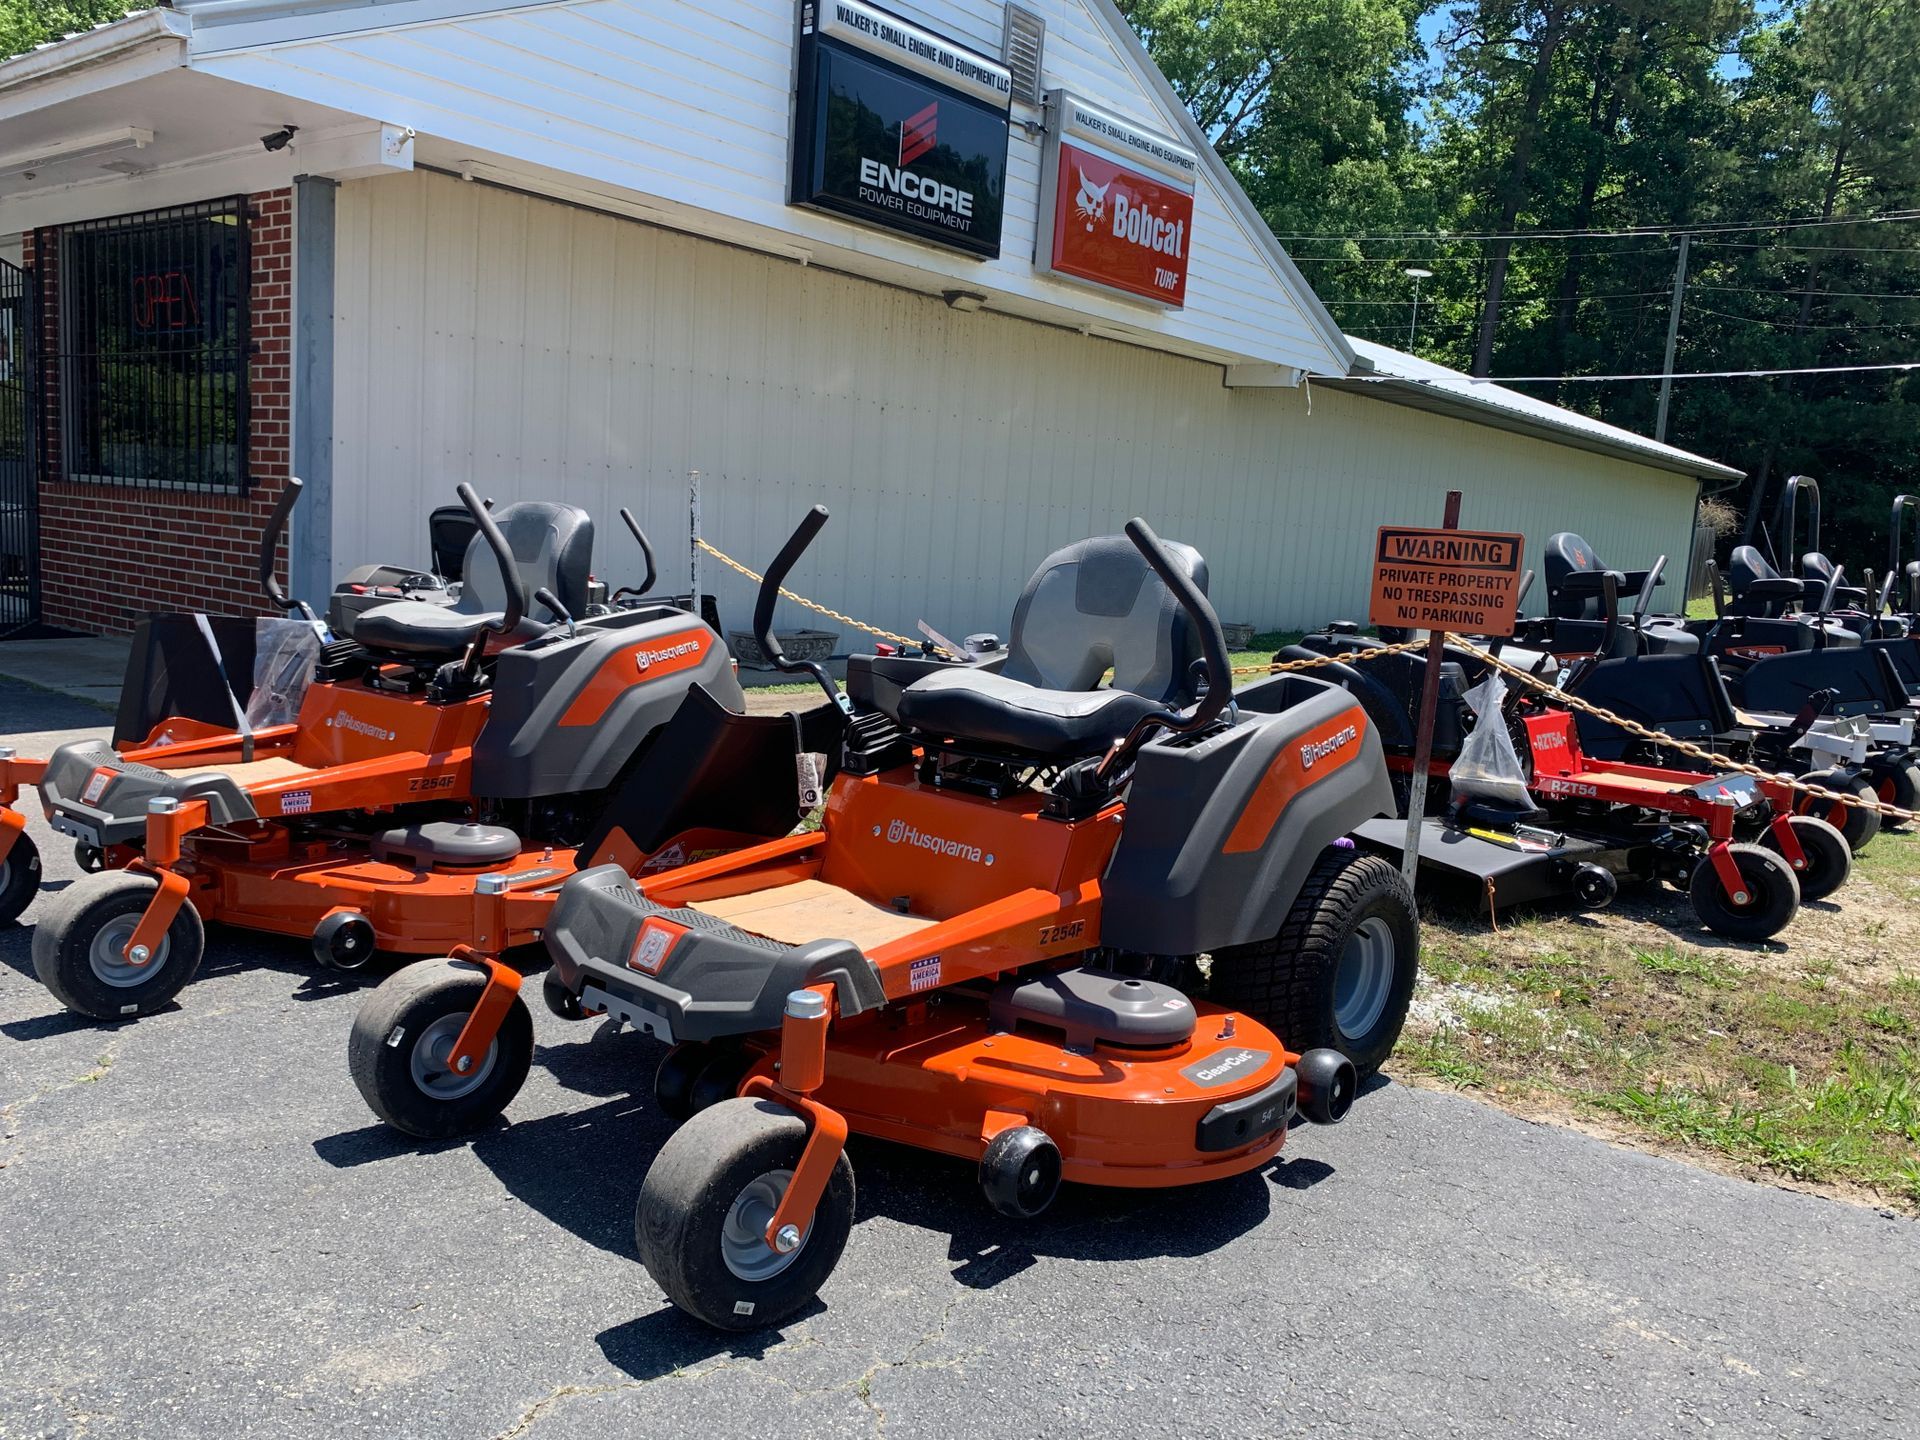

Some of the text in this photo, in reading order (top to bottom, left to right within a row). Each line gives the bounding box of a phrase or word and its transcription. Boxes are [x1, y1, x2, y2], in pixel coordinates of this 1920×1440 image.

[836, 4, 879, 37] WALKER'S
[880, 25, 907, 49] SMALL
[908, 38, 937, 62] ENGINE
[938, 53, 954, 70] AND
[955, 58, 998, 88] EQUIPMENT
[997, 76, 1010, 93] LLC
[1075, 111, 1195, 171] WALKER'S SMALL ENGINE AND EQUIPMENT
[860, 157, 974, 217] ENCORE
[859, 186, 972, 231] POWER EQUIPMENT
[1112, 193, 1184, 259] Bobcat
[1154, 267, 1179, 290] TURF
[134, 271, 200, 328] OPEN
[1395, 538, 1503, 563] WARNING
[1379, 568, 1513, 591] PRIVATE PROPERTY
[1382, 586, 1505, 609] NO TRESPASSING
[1397, 605, 1485, 625] NO PARKING
[647, 640, 700, 664] Husqvarna
[1311, 725, 1356, 761] Husqvarna
[1536, 731, 1564, 751] RZT54
[408, 776, 455, 791] Z 254F
[1551, 780, 1598, 797] RZT54
[283, 798, 310, 807] AMERICA
[902, 825, 982, 862] Husqvarna
[1039, 922, 1085, 945] Z 254F
[912, 968, 939, 982] AMERICA
